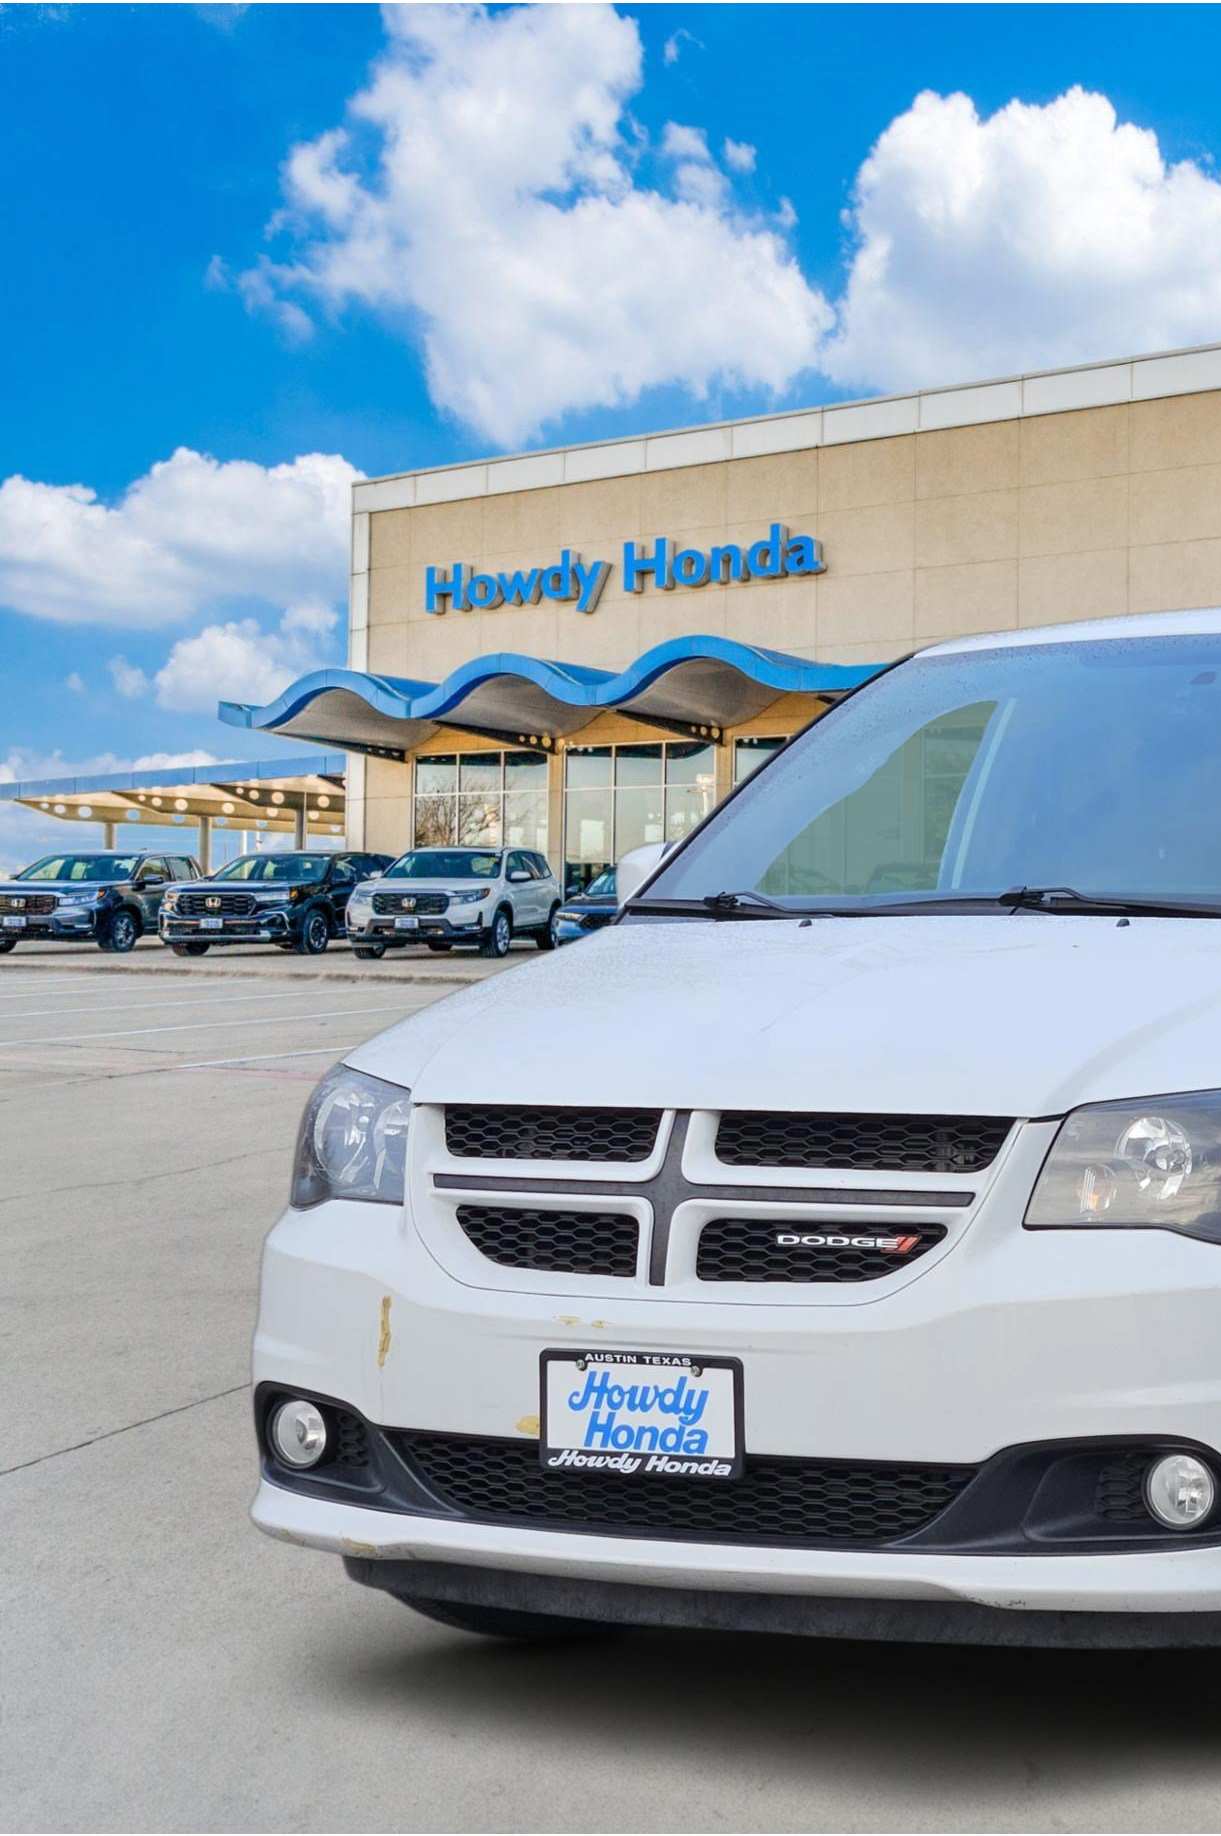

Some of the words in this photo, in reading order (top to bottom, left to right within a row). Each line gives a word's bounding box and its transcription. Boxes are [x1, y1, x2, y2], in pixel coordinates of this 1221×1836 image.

[425, 548, 612, 614] Howdy
[623, 522, 827, 594] Honda
[777, 1234, 899, 1249] DODGE
[584, 1352, 638, 1364] AUSTIN
[643, 1355, 692, 1367] TEXAS
[568, 1370, 709, 1426] Howdy
[583, 1411, 708, 1455] Honda
[547, 1449, 642, 1474] Howdy
[644, 1455, 732, 1477] Honda
